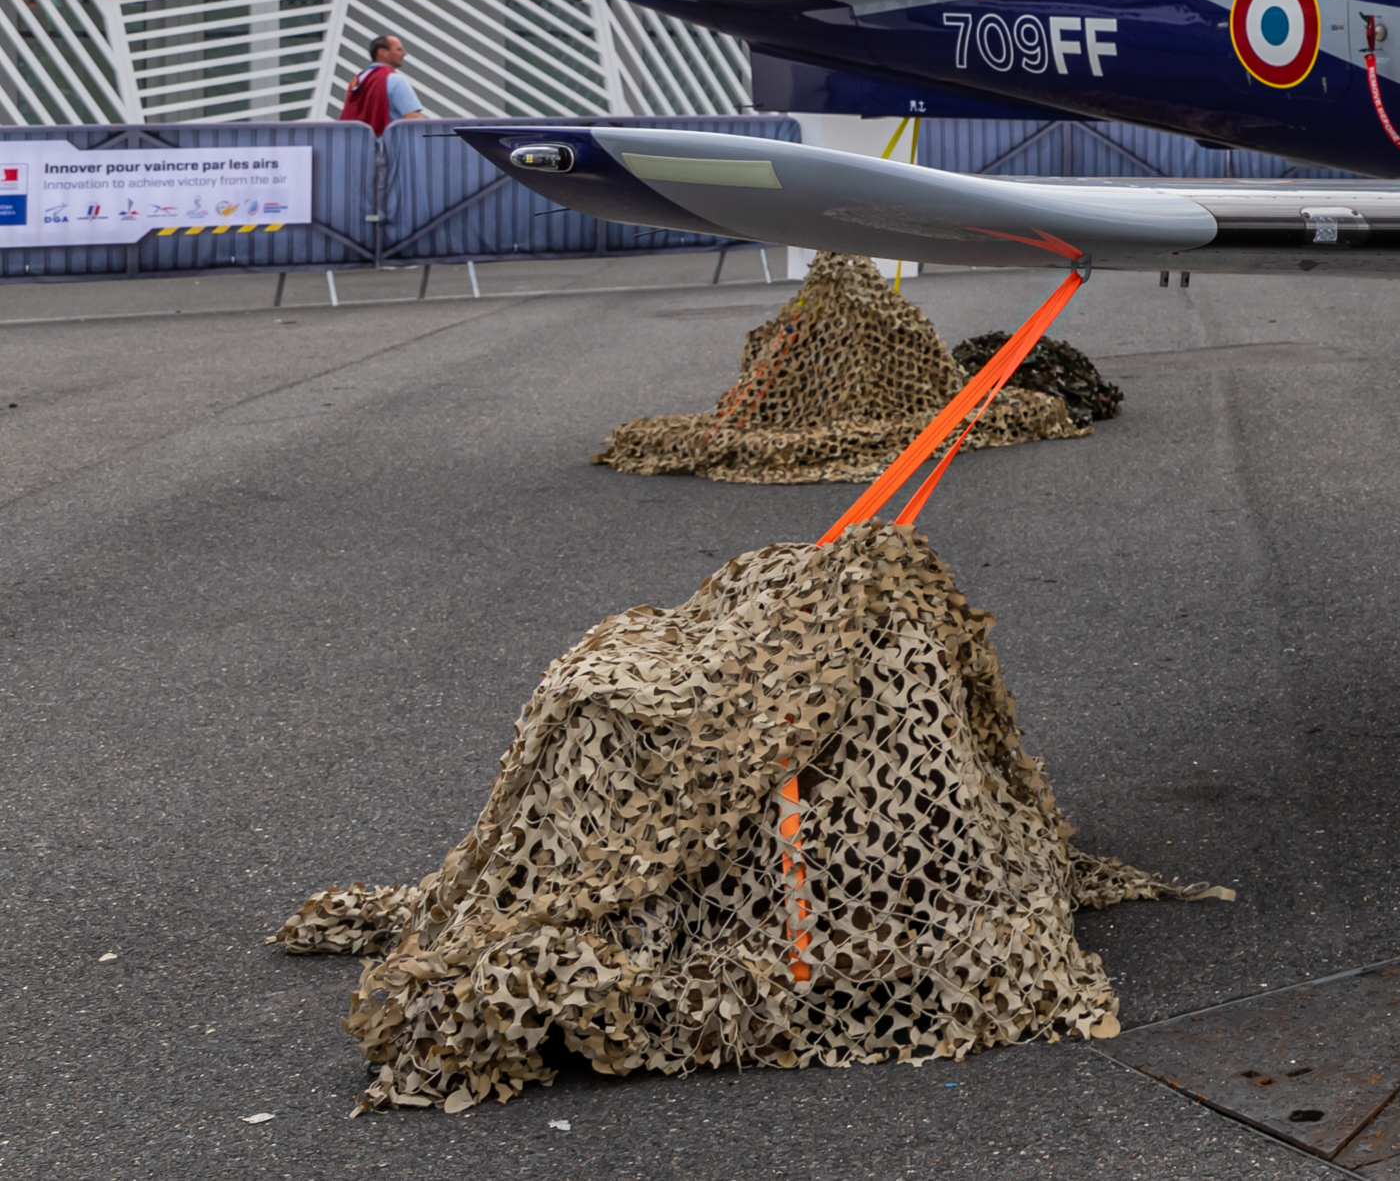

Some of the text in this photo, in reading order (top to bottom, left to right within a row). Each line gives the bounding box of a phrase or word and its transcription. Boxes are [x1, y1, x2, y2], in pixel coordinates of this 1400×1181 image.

[943, 12, 1118, 77] 709FF
[1368, 67, 1382, 106] REMOVE
[44, 159, 279, 175] Innover pour vaincre par les airs
[43, 174, 287, 190] Innovation to achieve victory from the air
[44, 216, 69, 224] DGA
